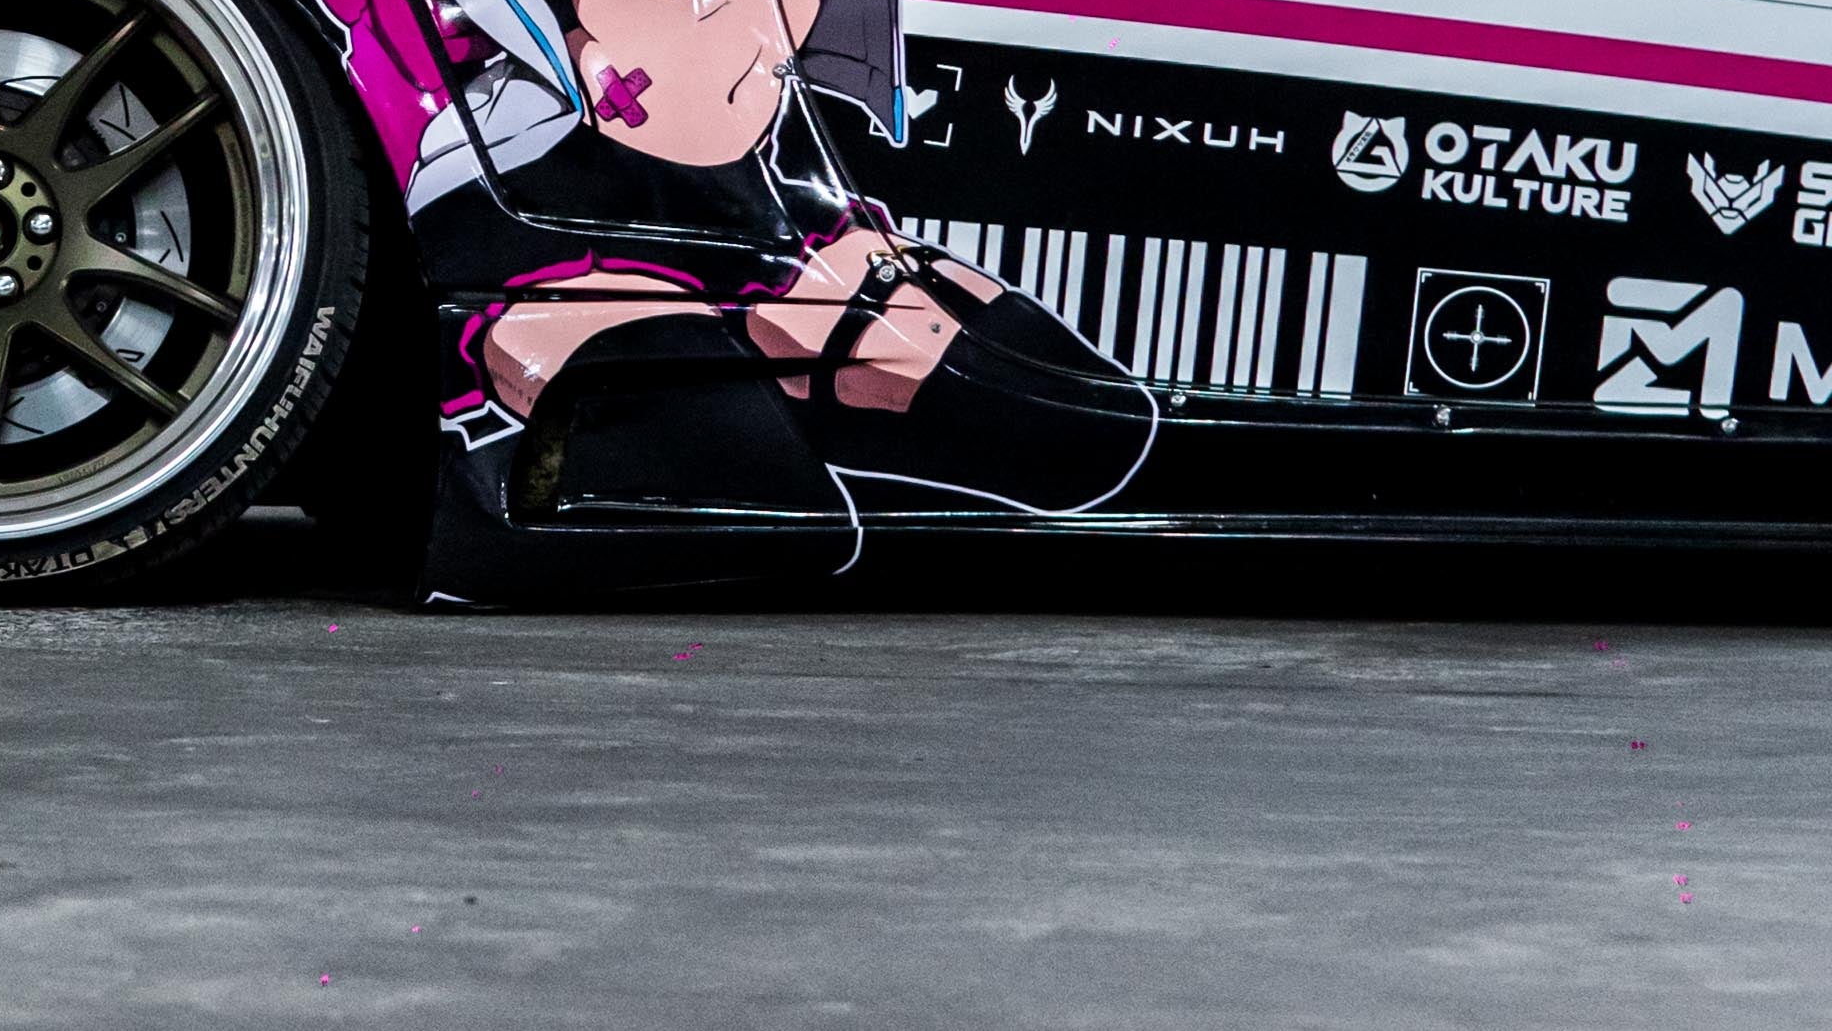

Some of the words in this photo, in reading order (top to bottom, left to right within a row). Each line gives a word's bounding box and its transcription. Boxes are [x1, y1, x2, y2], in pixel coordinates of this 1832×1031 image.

[1086, 109, 1285, 153] NIXUH
[1424, 121, 1638, 184] OTAKU
[1421, 169, 1631, 222] KULTURE
